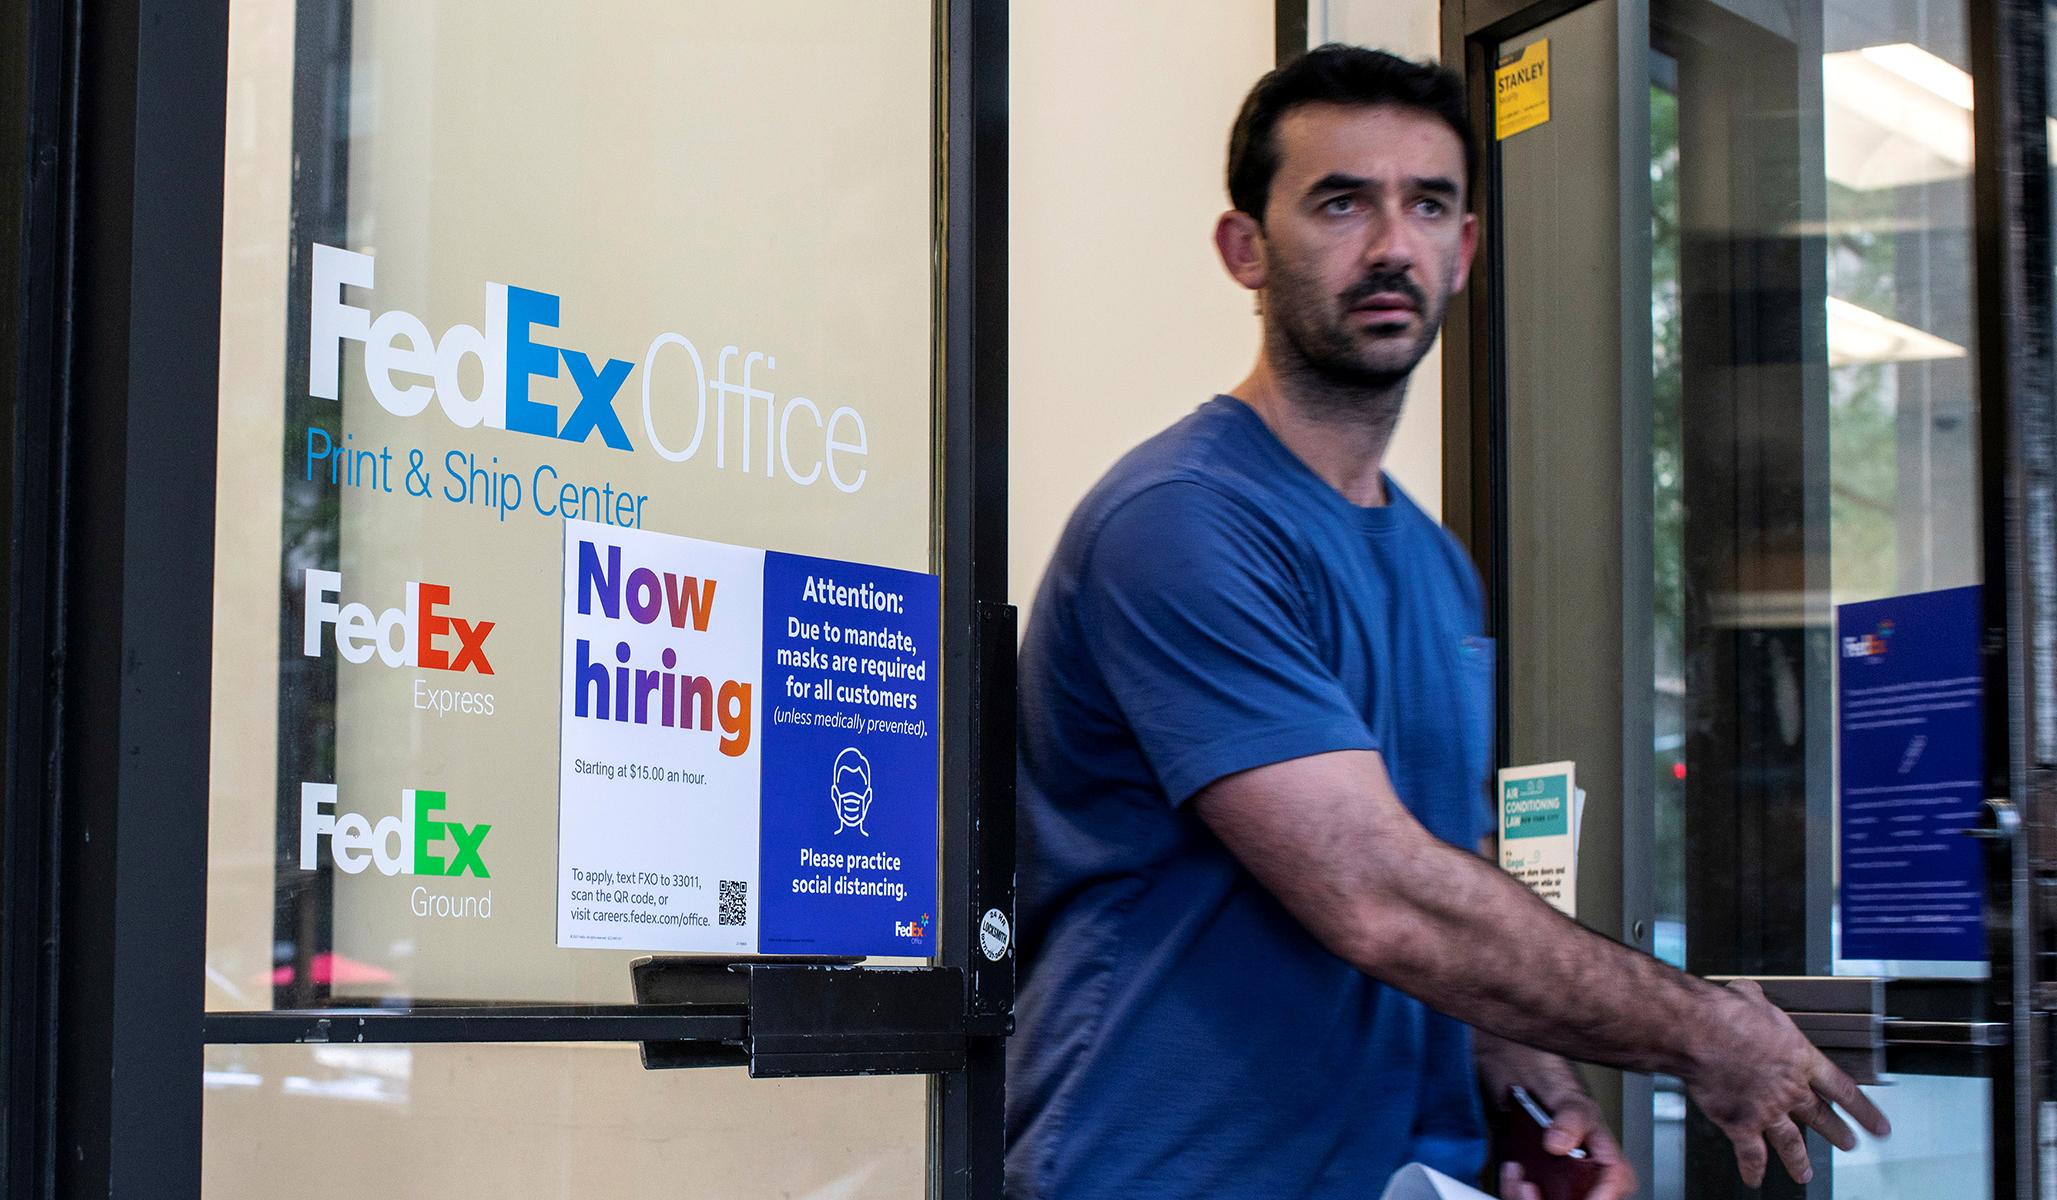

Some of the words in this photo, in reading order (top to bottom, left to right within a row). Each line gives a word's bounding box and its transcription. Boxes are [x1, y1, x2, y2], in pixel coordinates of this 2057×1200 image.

[1498, 62, 1544, 93] STANLEY
[310, 243, 634, 451] FedEx
[642, 332, 867, 493] Office
[307, 427, 392, 493] Print
[405, 450, 432, 498] &
[443, 450, 521, 521] Ship
[532, 465, 648, 529] Center
[578, 541, 717, 632] Now
[802, 576, 903, 614] Attention:
[304, 569, 496, 674] FedEx
[788, 617, 820, 640] Due
[823, 621, 841, 642] to
[845, 627, 917, 654] mandate,
[778, 647, 828, 670] masks
[832, 654, 857, 672] are
[862, 656, 926, 682] required
[414, 680, 494, 717] Express
[574, 639, 752, 757] hiring
[786, 675, 810, 698] for
[814, 678, 832, 701] all
[836, 684, 916, 709] customers
[774, 706, 812, 724] (unless
[814, 712, 866, 735] medically
[867, 719, 928, 738] prevented).
[575, 759, 615, 779] Starting
[617, 764, 627, 777] at
[630, 763, 665, 782] $15.00
[668, 769, 680, 782] an
[682, 769, 707, 785] hour.
[1506, 788, 1518, 799] AIR
[1506, 798, 1560, 814] CONDITIONING
[300, 782, 491, 878] FedEx
[1506, 815, 1521, 828] LAW
[800, 848, 844, 868] Please
[847, 851, 900, 872] practice
[572, 868, 583, 881] To
[586, 870, 614, 885] apply,
[617, 872, 636, 884] text
[639, 873, 658, 885] FXO
[660, 874, 670, 886] to
[673, 875, 702, 890] 33011,
[792, 874, 831, 894] social
[834, 874, 907, 902] distancing.
[411, 886, 491, 917] Ground
[571, 890, 593, 901] scan
[596, 890, 611, 902] the
[614, 890, 628, 904] QR
[631, 892, 656, 906] code,
[659, 895, 668, 905] or
[571, 906, 590, 920] visit
[593, 909, 710, 927] careers.fedex.com/office.
[896, 921, 923, 937] FedEx
[983, 920, 1007, 944] LOCKSMITH
[998, 914, 1006, 926] HR
